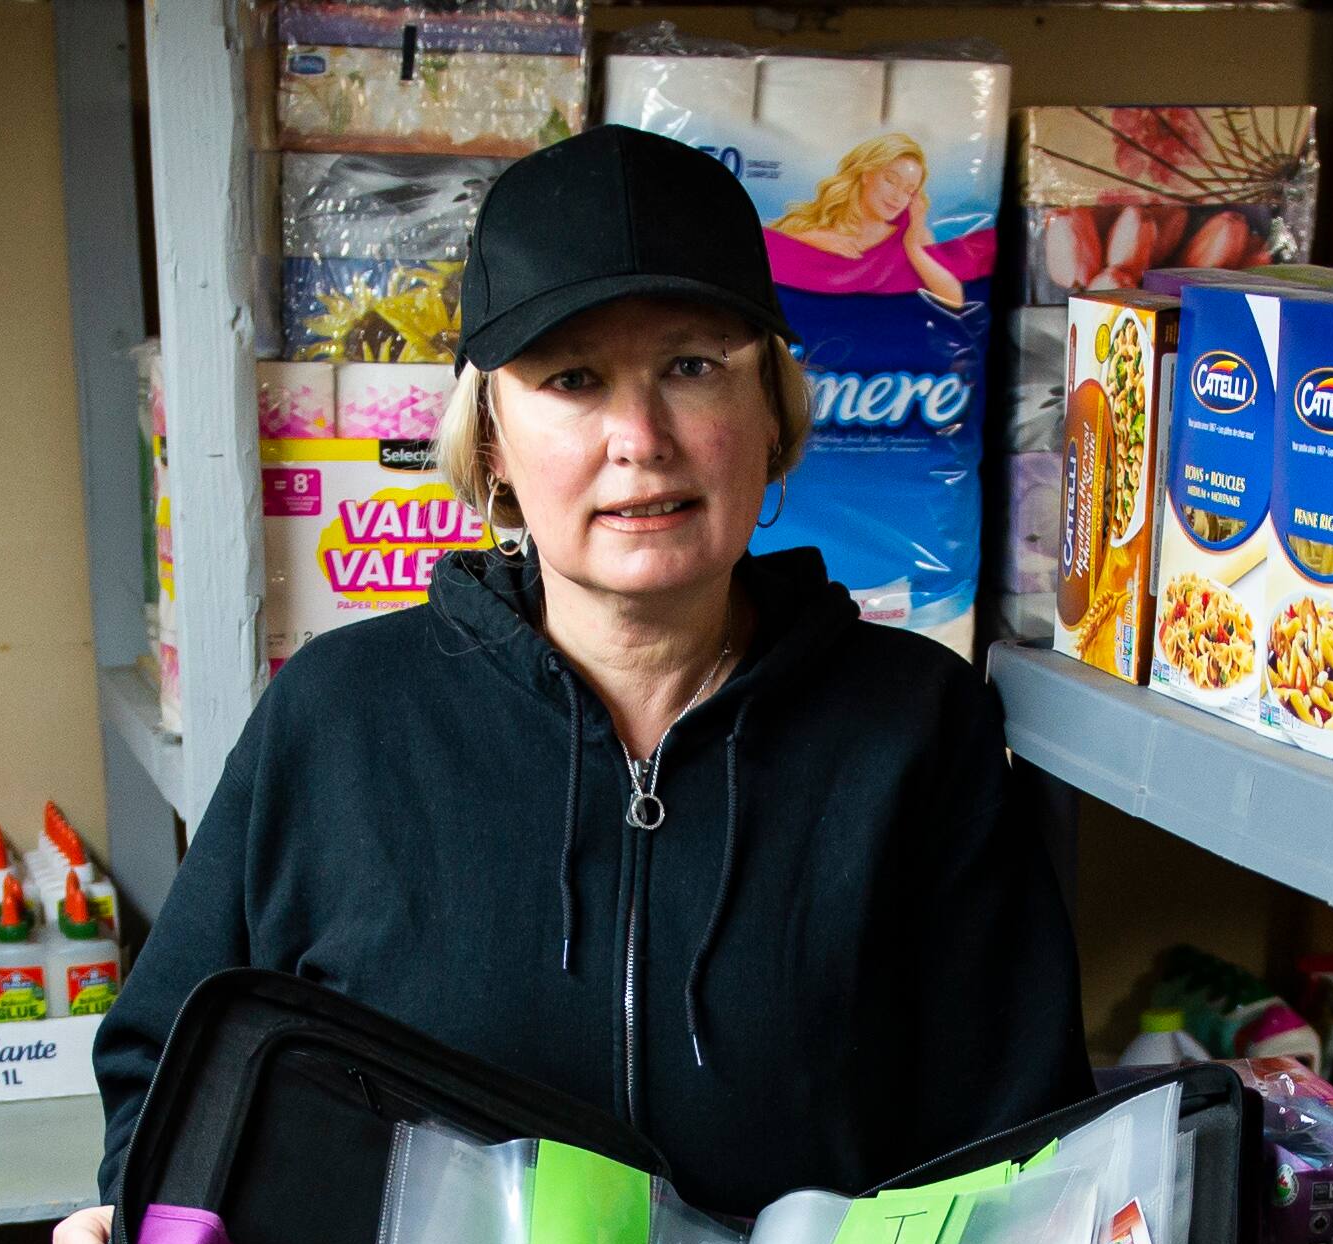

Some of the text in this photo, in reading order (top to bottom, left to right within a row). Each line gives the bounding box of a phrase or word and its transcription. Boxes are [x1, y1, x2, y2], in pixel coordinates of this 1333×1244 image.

[1196, 362, 1247, 402] CATELLI
[1185, 463, 1246, 493] BOWS BOUCLES
[344, 500, 485, 540] VALUE
[1063, 456, 1077, 568] CATELLI
[1294, 507, 1319, 529] PENNE
[336, 600, 373, 610] PAPER
[1, 1069, 23, 1086] 1L
